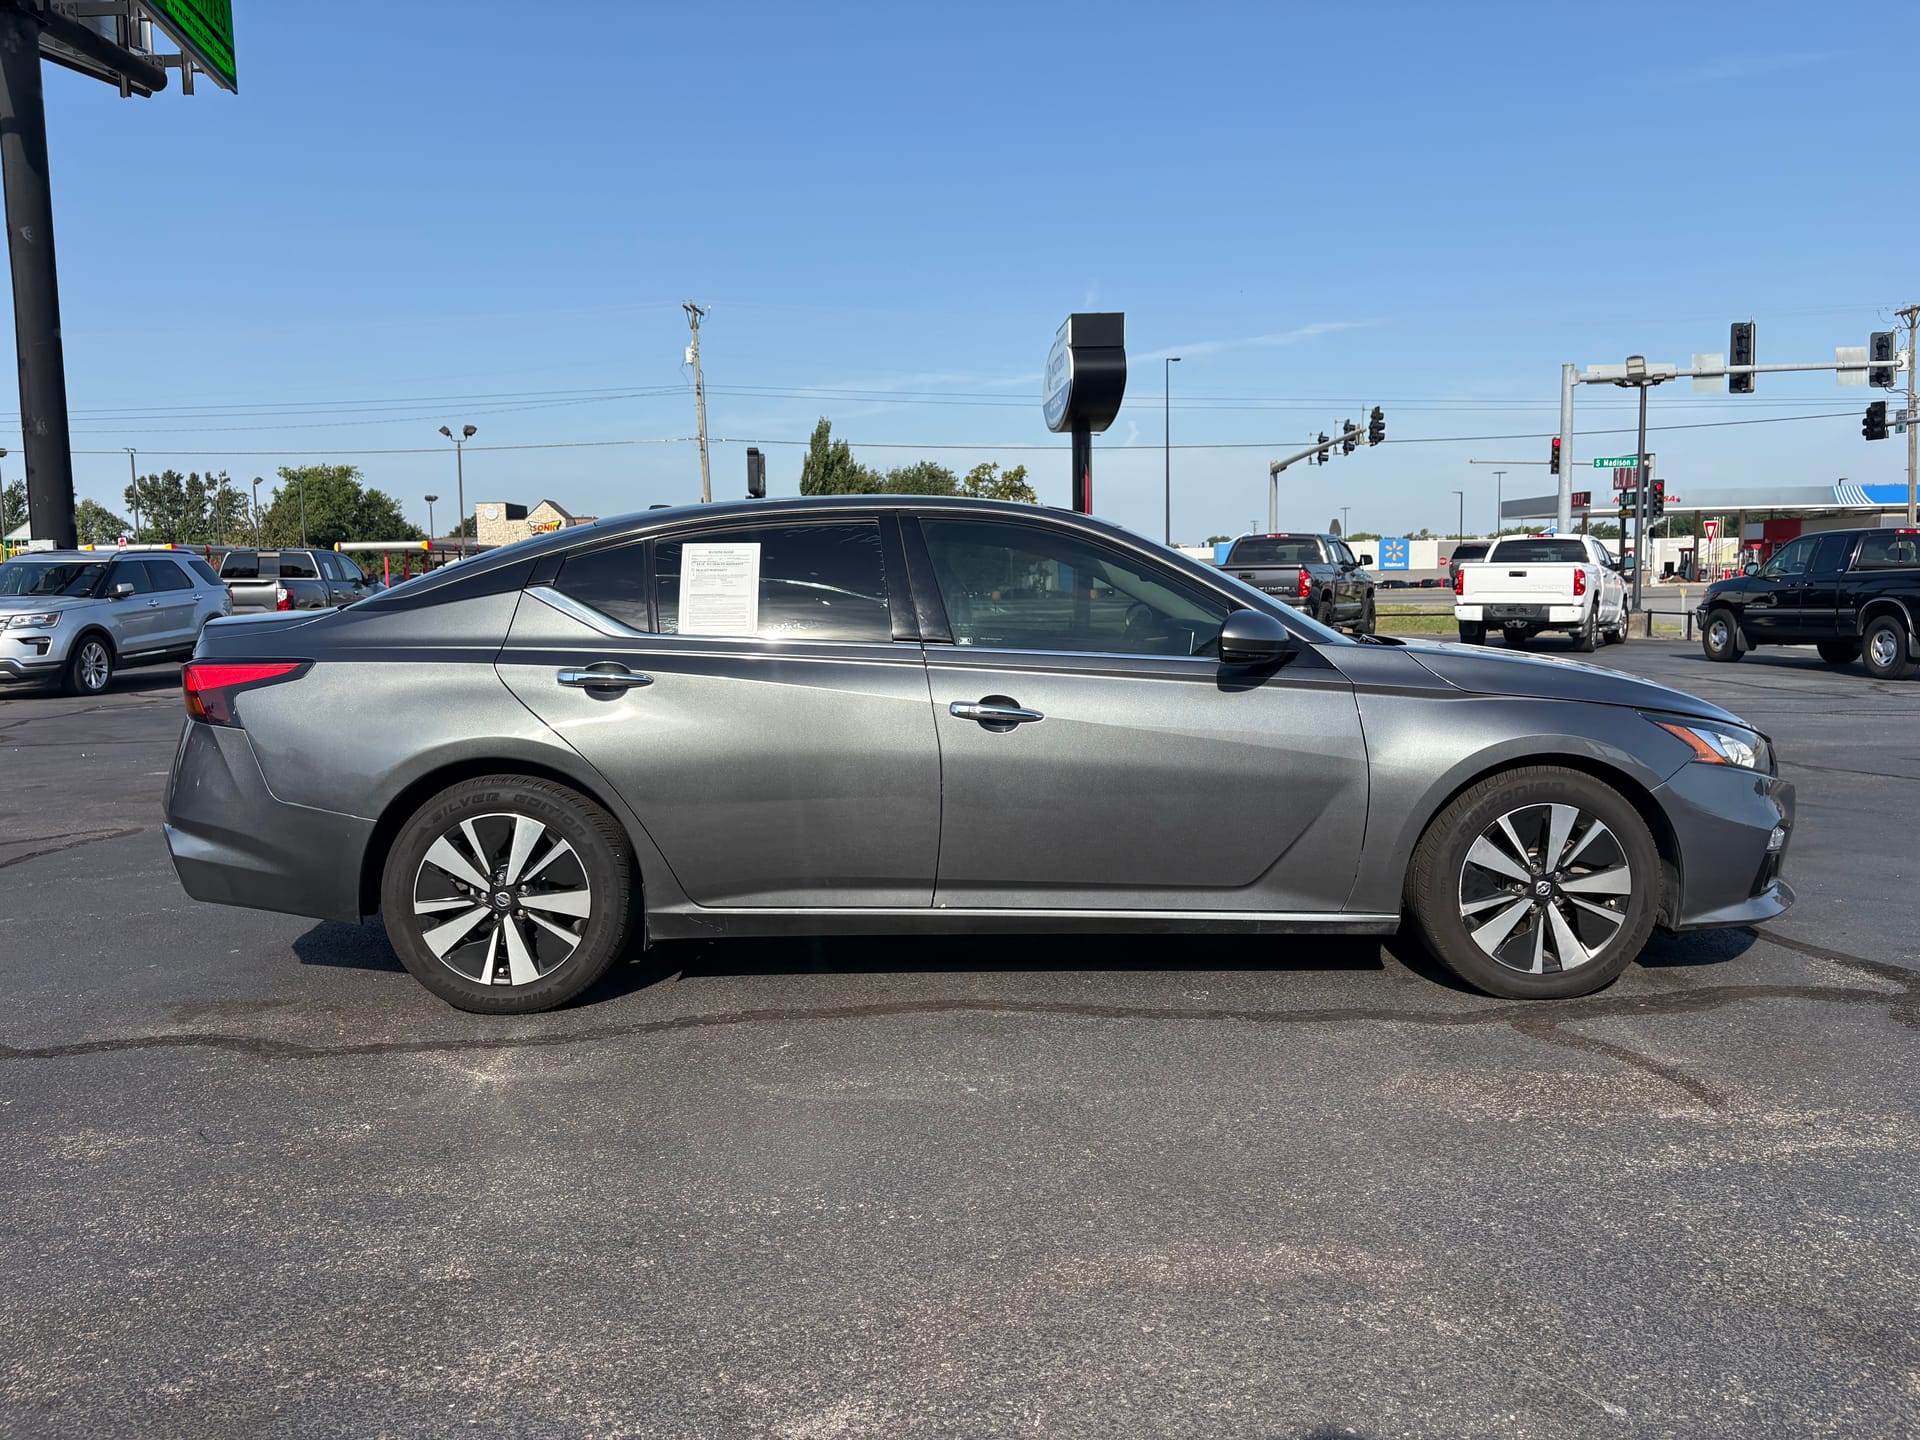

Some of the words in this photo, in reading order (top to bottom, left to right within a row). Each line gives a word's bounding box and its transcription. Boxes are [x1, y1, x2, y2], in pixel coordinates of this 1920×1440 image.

[1595, 459, 1600, 467] S
[1603, 458, 1631, 467] Madison
[532, 524, 557, 532] SONIC
[432, 792, 500, 825] SILVER
[512, 793, 588, 838] EDITION
